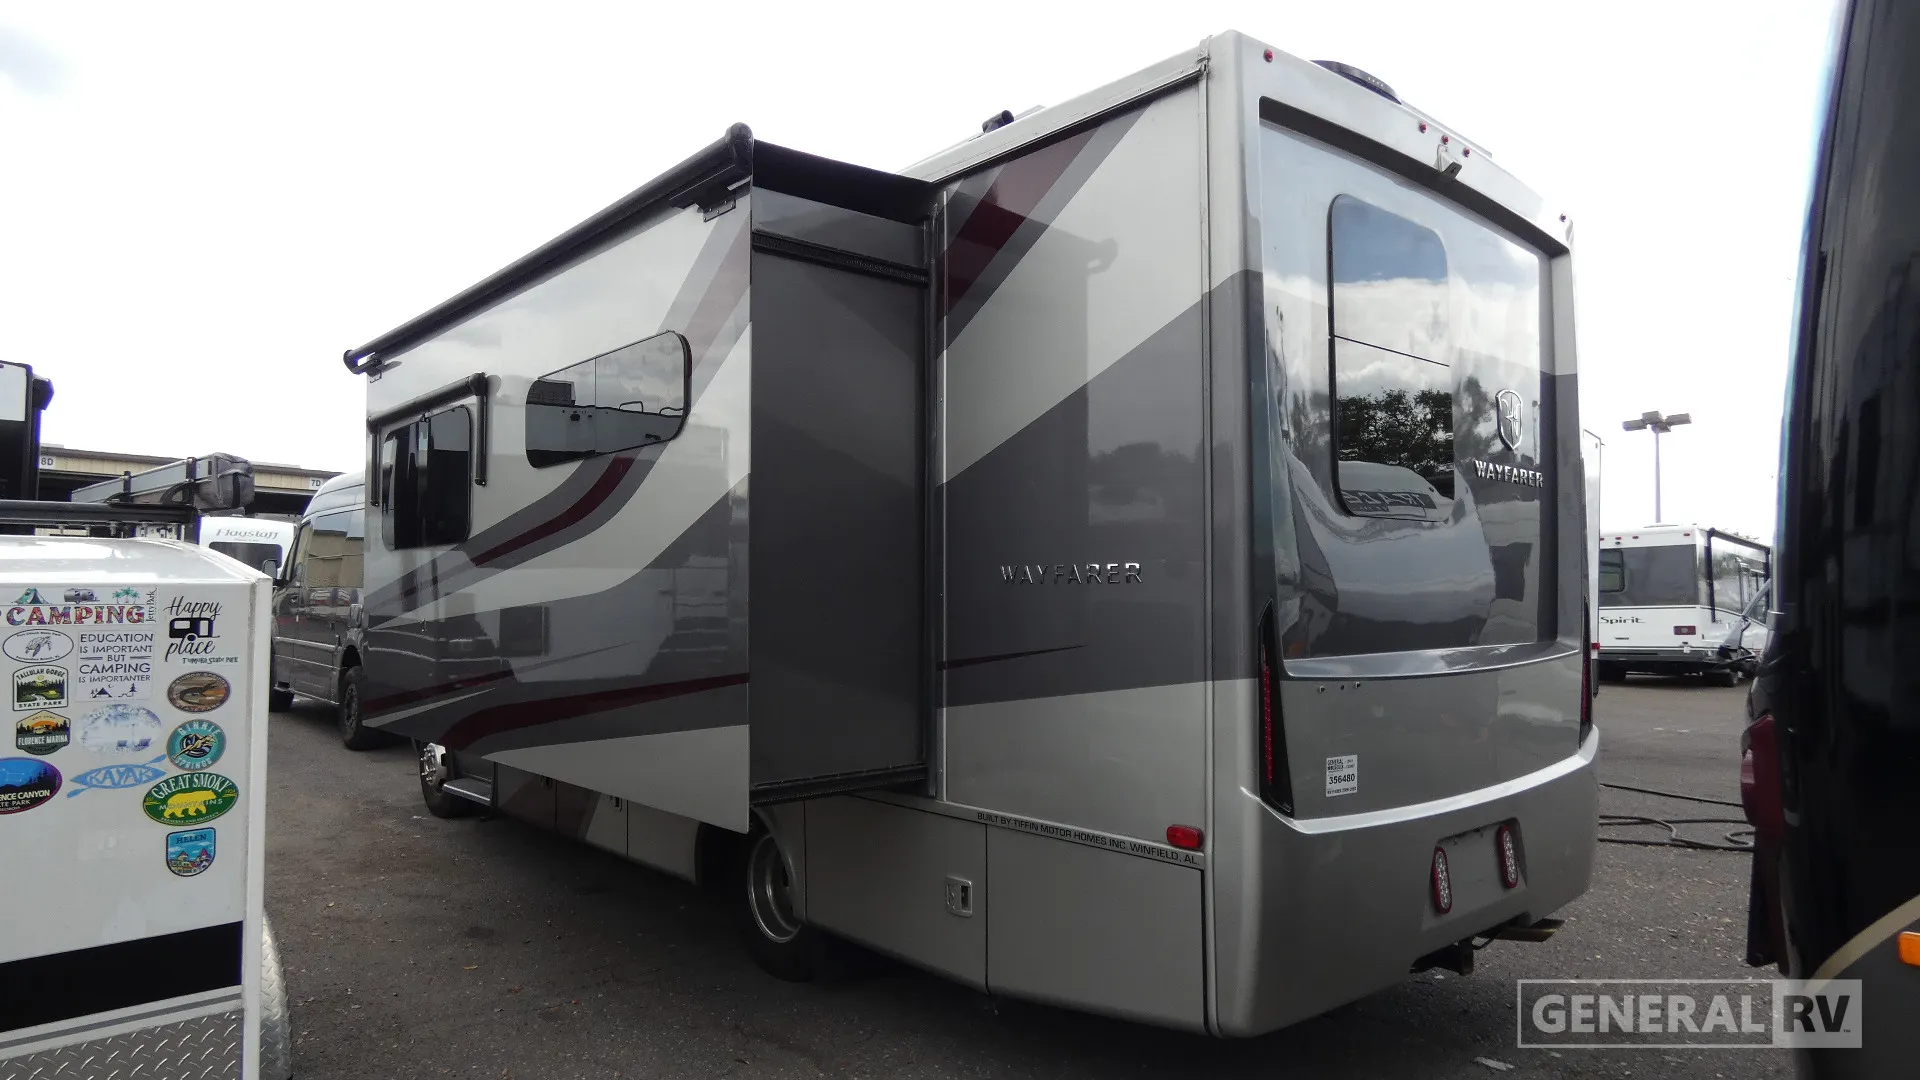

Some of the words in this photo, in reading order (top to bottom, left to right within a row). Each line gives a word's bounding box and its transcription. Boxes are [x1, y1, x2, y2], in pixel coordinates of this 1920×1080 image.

[40, 457, 54, 466] 8D
[1474, 459, 1543, 488] WAYFARER
[311, 479, 321, 487] 7D
[215, 528, 280, 540] Flagstaff
[1000, 562, 1143, 585] WAYFARER
[163, 596, 222, 622] Happy
[6, 606, 145, 626] CAMPING
[1600, 616, 1645, 624] Spirit
[80, 633, 154, 643] EDUCATION
[79, 646, 88, 654] IS
[92, 645, 152, 654] IMPORTANT
[164, 637, 216, 663] place
[107, 654, 126, 662] BUT
[16, 668, 44, 680] TALLULAH
[45, 668, 66, 678] GORGE
[79, 662, 151, 675] CAMPING
[78, 676, 86, 684] IS
[89, 674, 151, 684] IMPORTANTER
[178, 721, 221, 737] GINNIE
[18, 736, 46, 746] FLORENCE
[46, 734, 68, 743] MARINA
[174, 757, 213, 769] SPRINGS
[1329, 773, 1356, 785] 356480
[151, 774, 191, 799] GREAT
[192, 773, 232, 792] SMOKY
[17, 789, 51, 799] CANYON
[12, 799, 31, 807] PARK
[175, 834, 207, 844] HELEN
[977, 812, 999, 823] BUILT
[1000, 816, 1012, 826] BY
[1013, 819, 1039, 832] TIFFIN
[1040, 824, 1072, 839] MOTOR
[1074, 832, 1107, 846] HOMES
[1130, 843, 1182, 863] WINFIELD,
